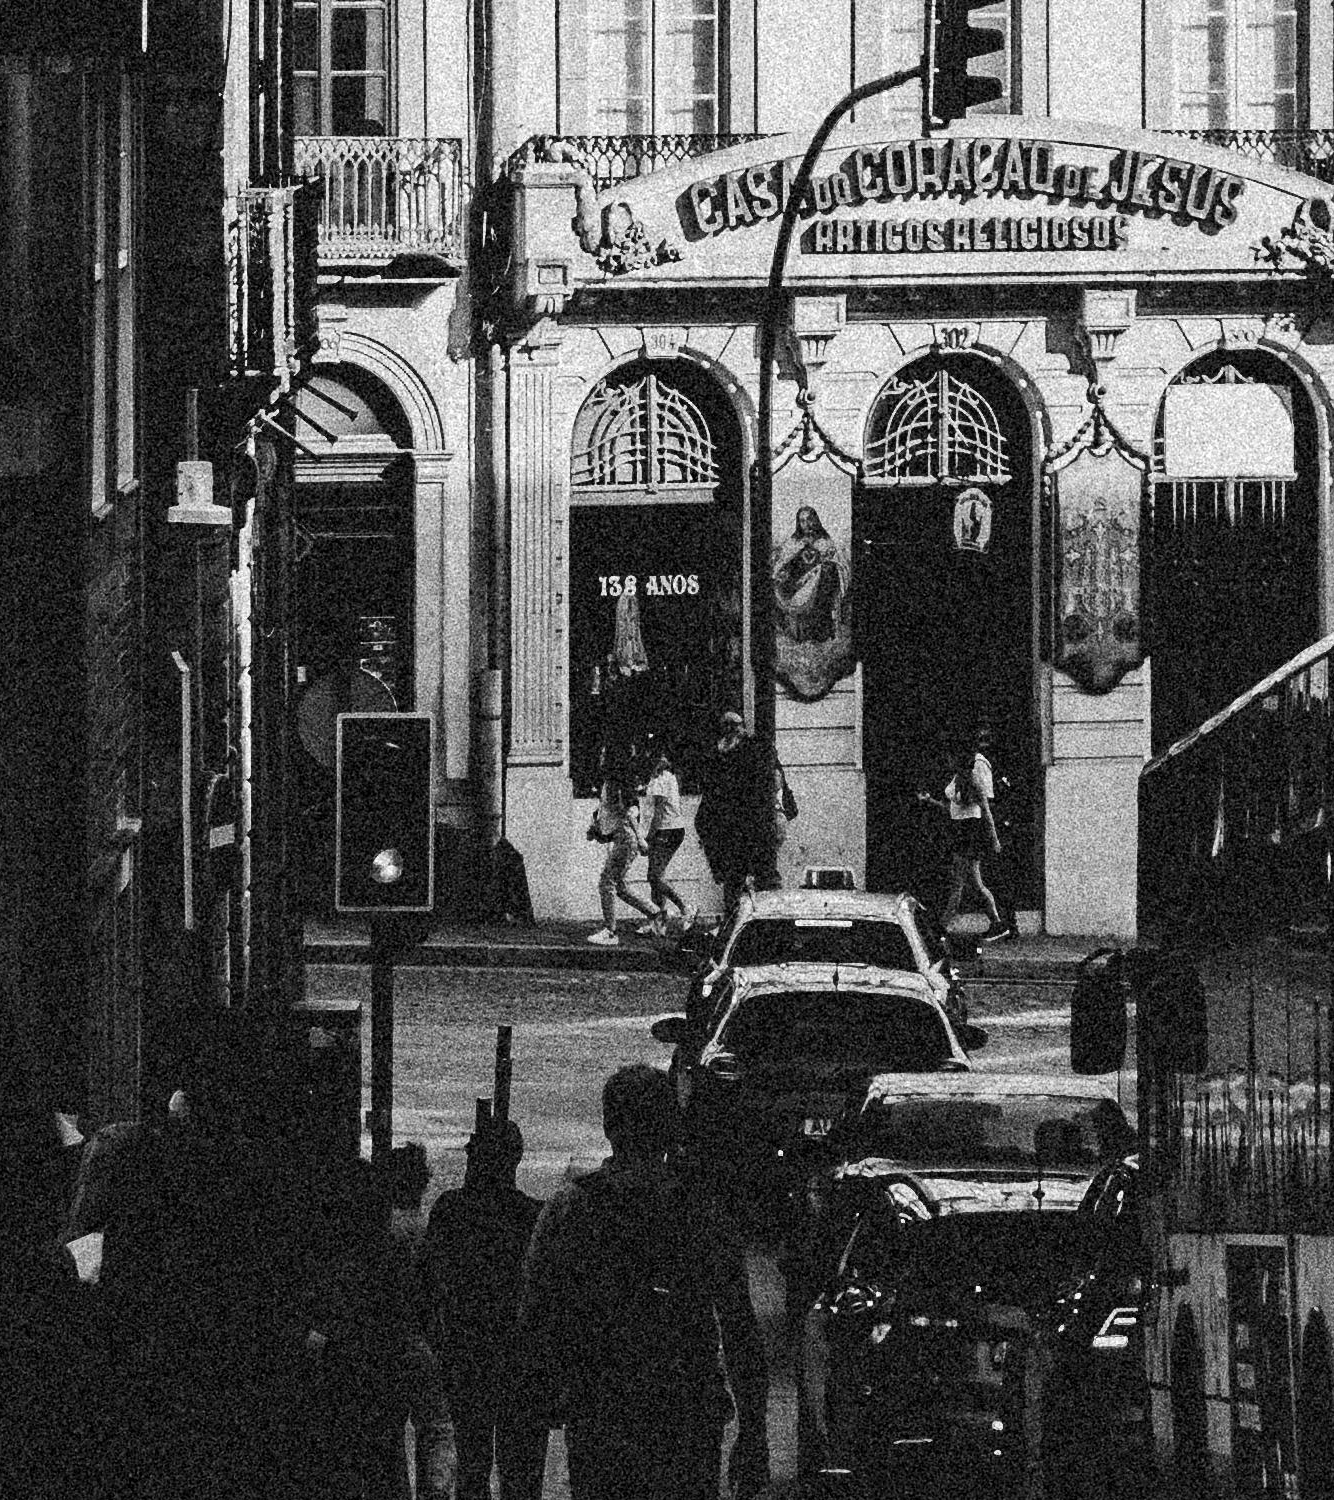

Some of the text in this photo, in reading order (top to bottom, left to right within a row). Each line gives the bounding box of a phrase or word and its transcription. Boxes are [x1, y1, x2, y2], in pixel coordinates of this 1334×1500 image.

[1106, 149, 1247, 229] JESUS
[808, 214, 1131, 253] ARTIGOS RELIGIOSOS
[645, 573, 701, 597] ANOS
